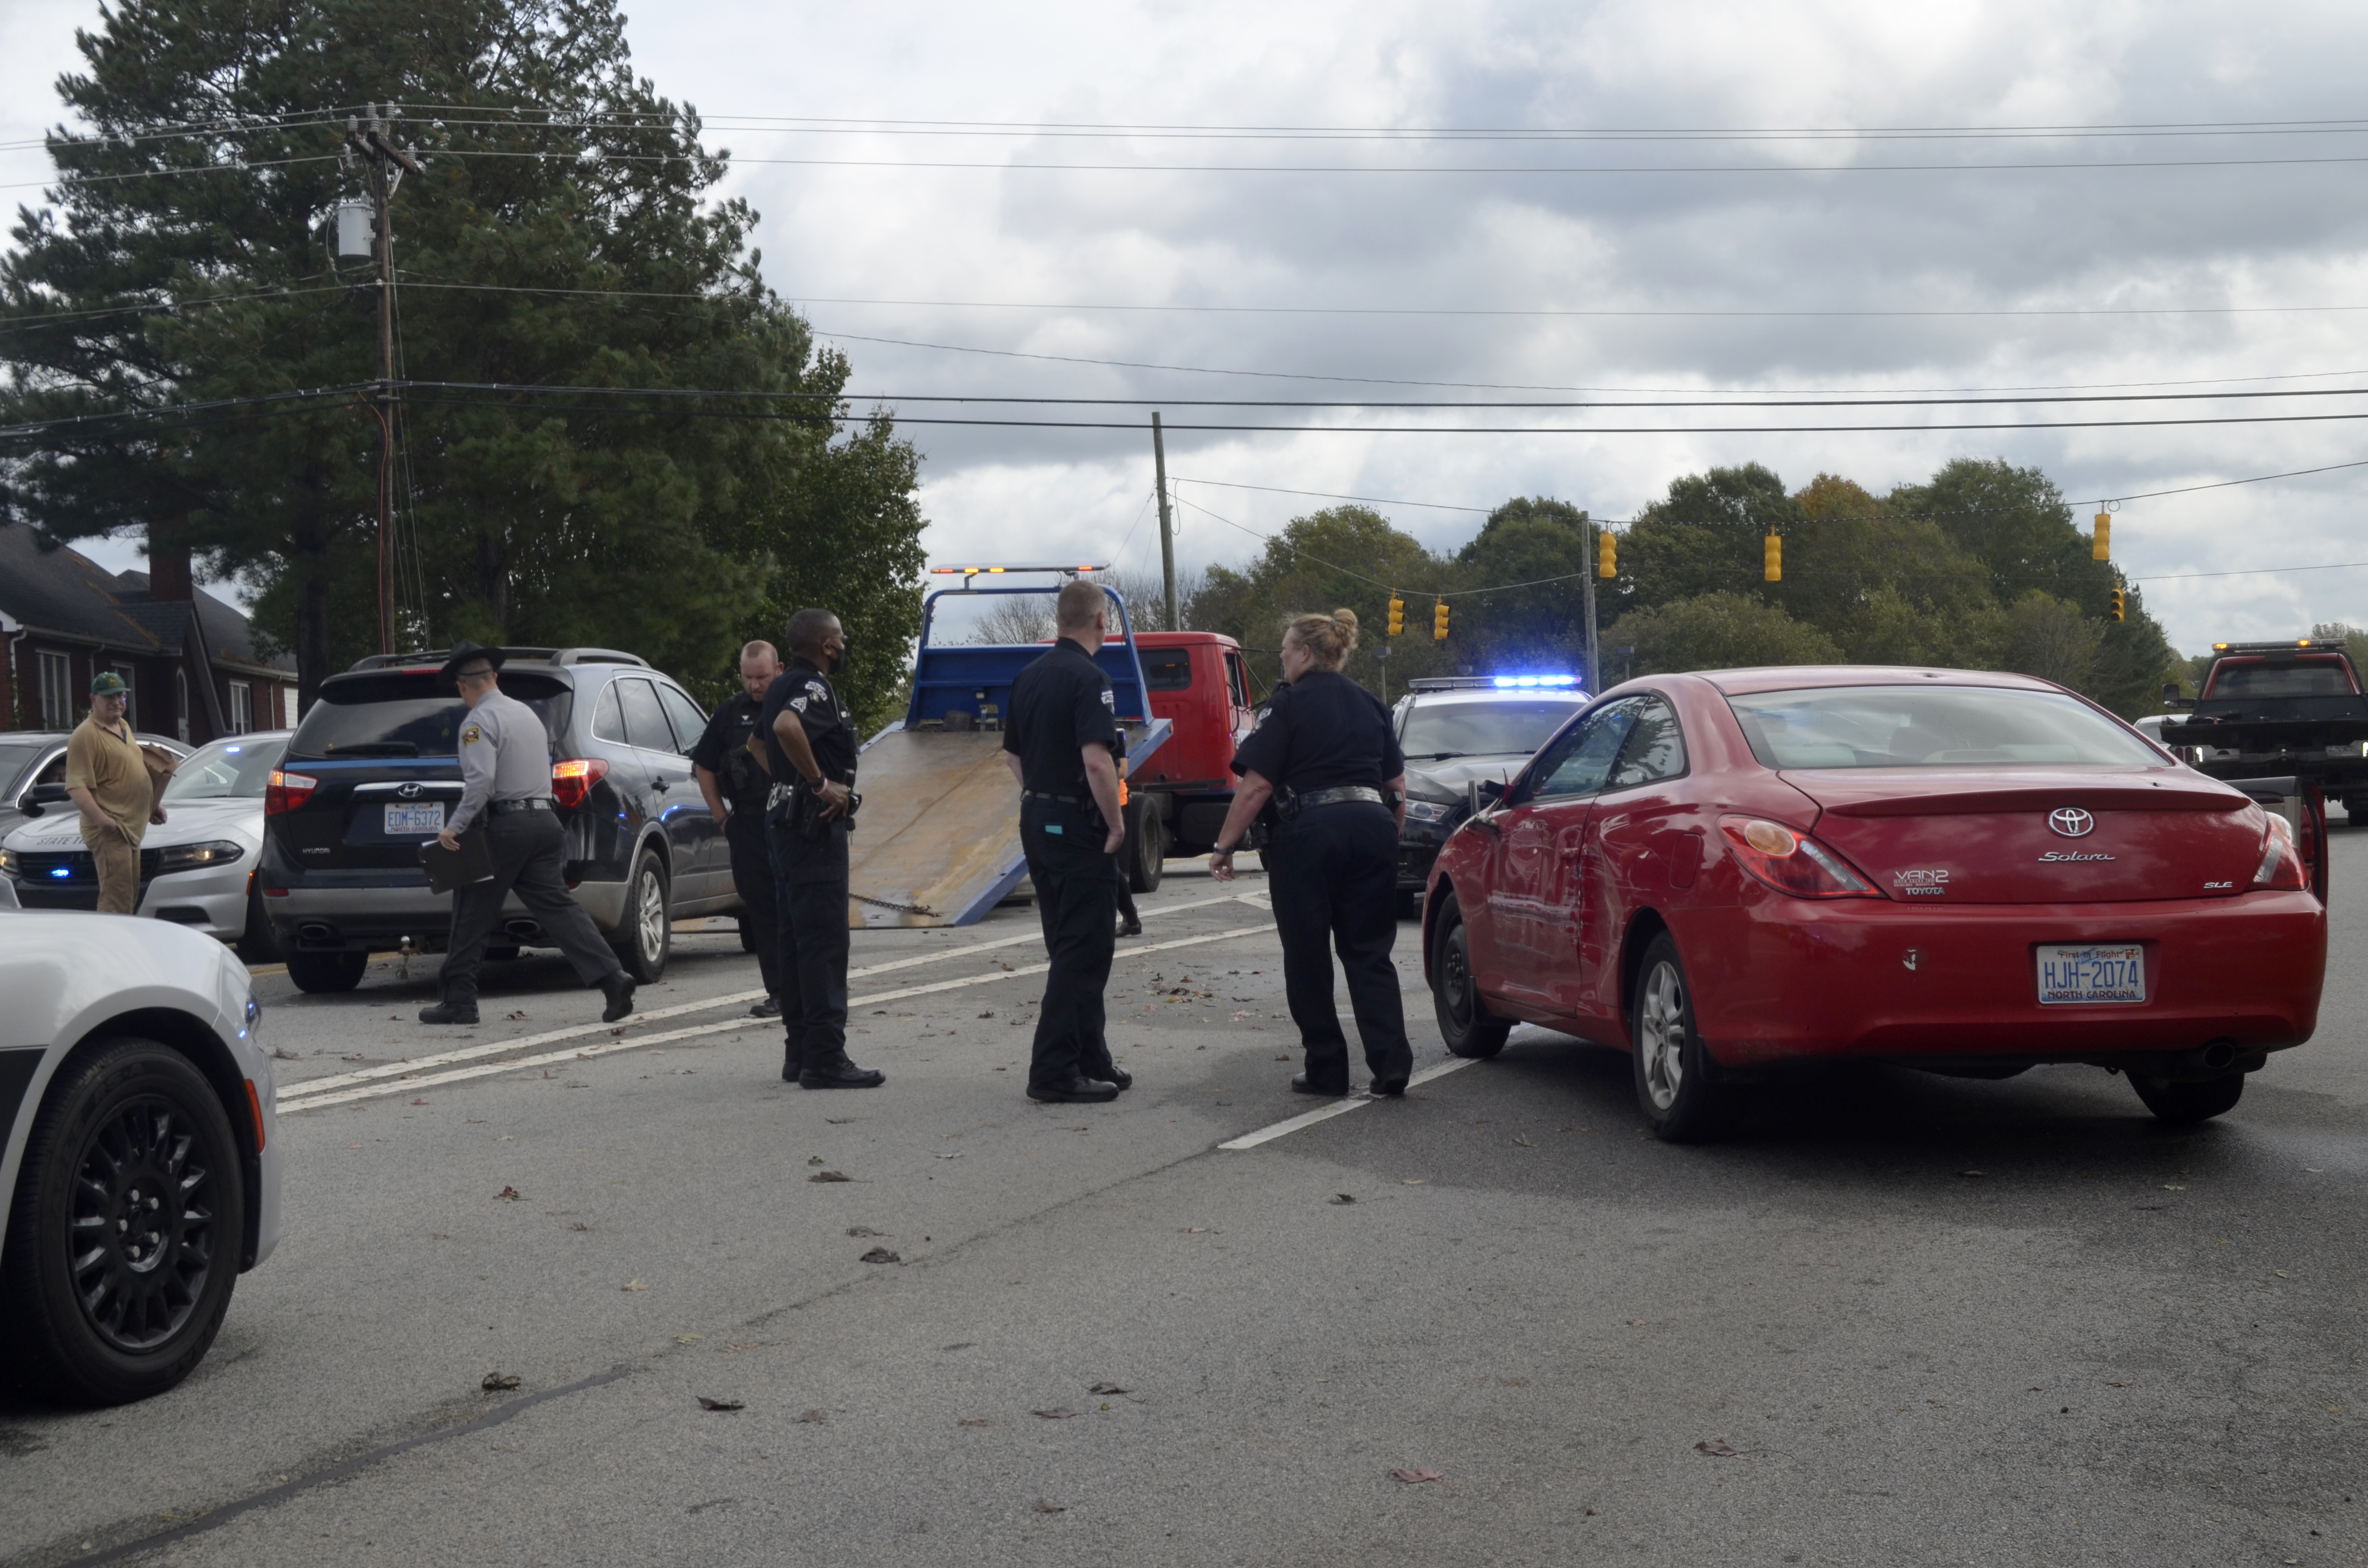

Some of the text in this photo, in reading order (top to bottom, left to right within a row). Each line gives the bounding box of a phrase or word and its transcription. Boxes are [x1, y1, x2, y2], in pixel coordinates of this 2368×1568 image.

[37, 837, 72, 845] STATE
[2038, 851, 2116, 861] Solara
[2044, 961, 2139, 989] HJH-2074
[2048, 990, 2136, 999] NORTH CAROLINA
